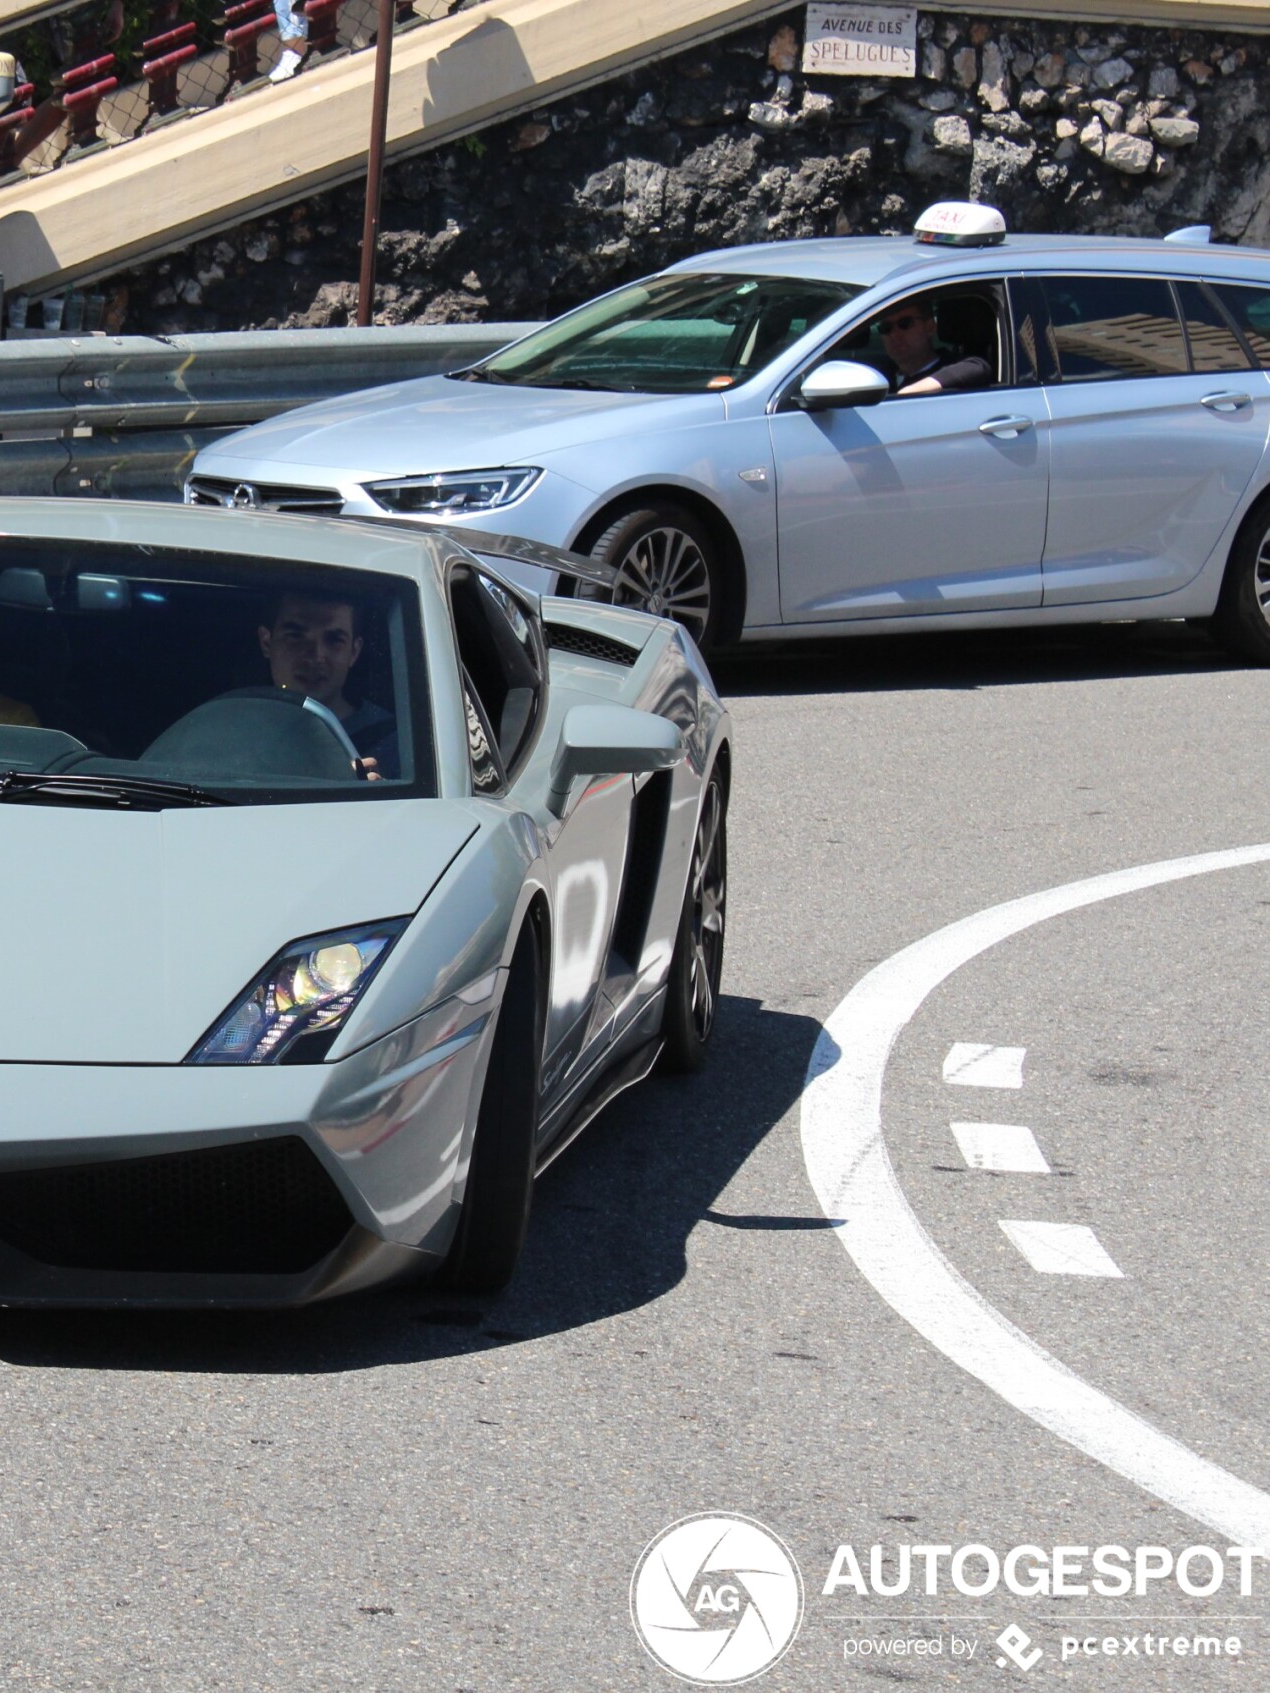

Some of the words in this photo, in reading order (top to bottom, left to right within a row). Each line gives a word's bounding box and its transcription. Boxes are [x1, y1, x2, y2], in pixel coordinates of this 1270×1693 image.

[821, 18, 873, 33] AVENUE
[878, 21, 903, 34] DES
[810, 41, 911, 63] SPELUGUES
[933, 210, 967, 224] TAXI
